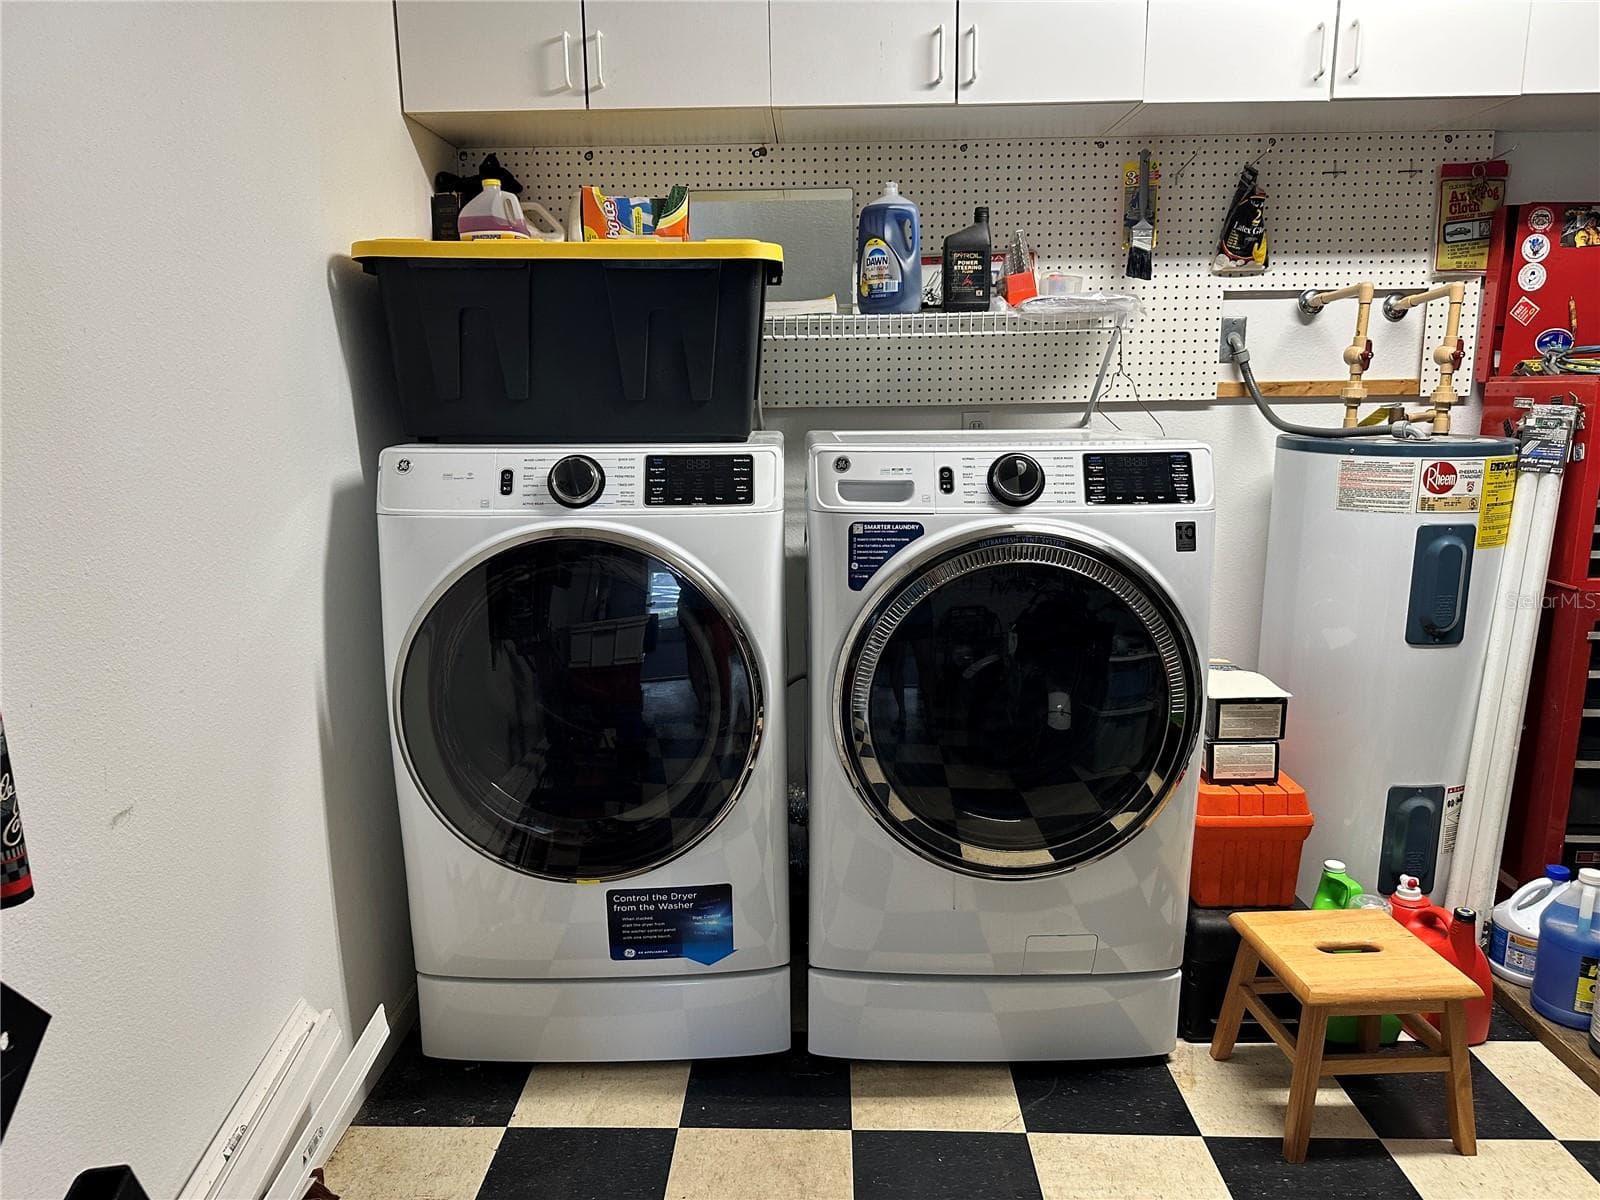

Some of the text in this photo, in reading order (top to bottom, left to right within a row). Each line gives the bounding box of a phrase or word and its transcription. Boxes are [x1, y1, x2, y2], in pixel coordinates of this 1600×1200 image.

[1125, 171, 1137, 186] 3
[1234, 221, 1251, 234] Latex
[866, 256, 888, 266] DAWN
[1427, 463, 1456, 490] Rheem
[613, 894, 649, 902] Control
[671, 892, 697, 902] Dryer
[613, 904, 637, 912] from
[658, 902, 694, 910] Washer
